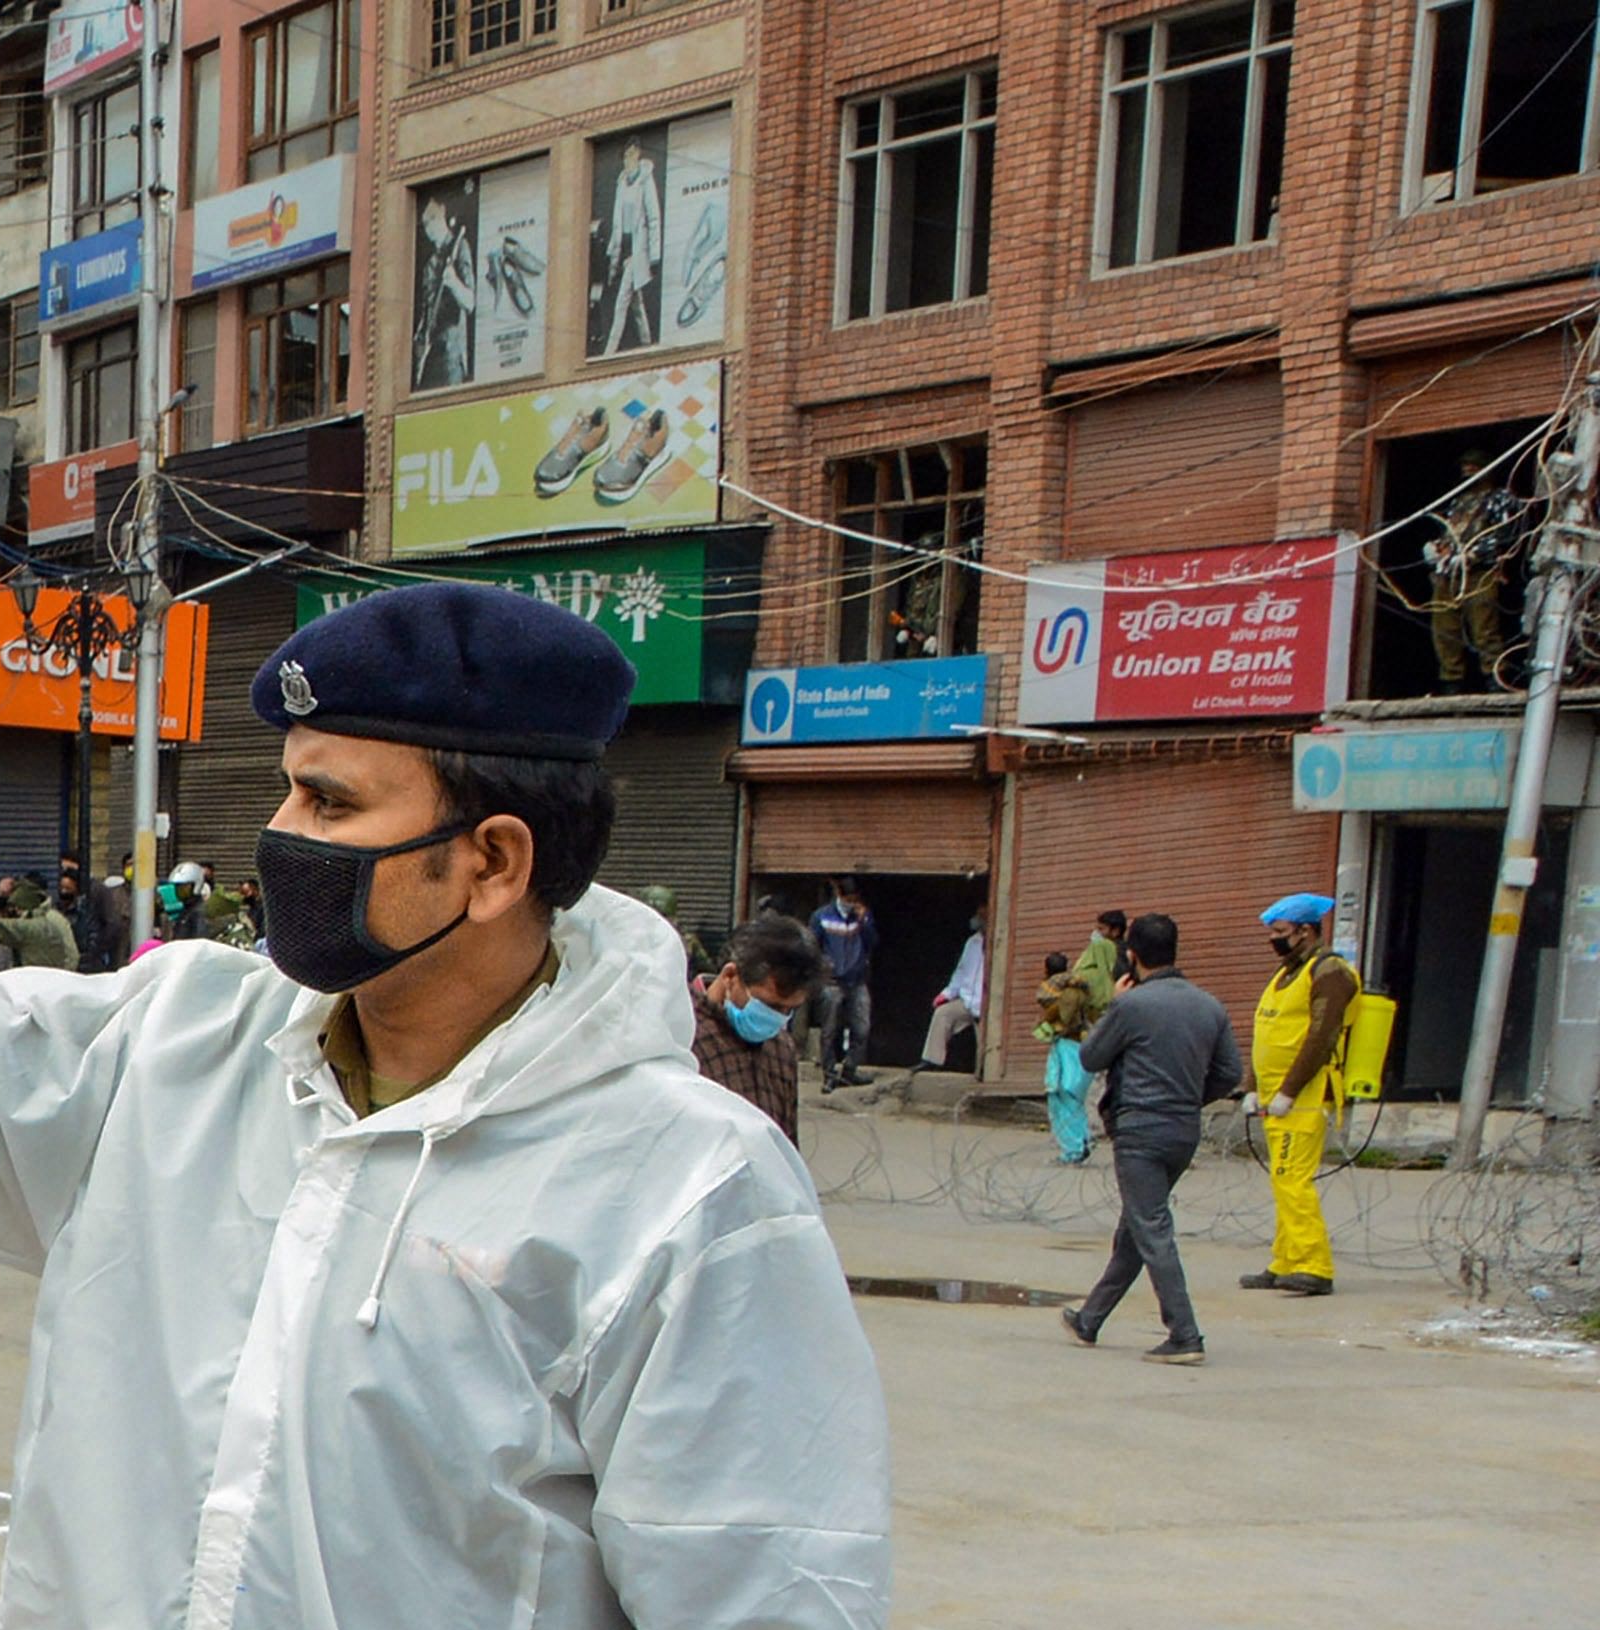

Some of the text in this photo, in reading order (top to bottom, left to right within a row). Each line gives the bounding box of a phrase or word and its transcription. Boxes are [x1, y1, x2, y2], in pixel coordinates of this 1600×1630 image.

[397, 440, 500, 512] FILA
[1118, 591, 1302, 641] यूनियन बैंक
[1111, 646, 1295, 678] Union Bank
[797, 688, 822, 704] State
[824, 686, 850, 702] Bank
[865, 684, 891, 699] India
[1230, 673, 1292, 688] of India
